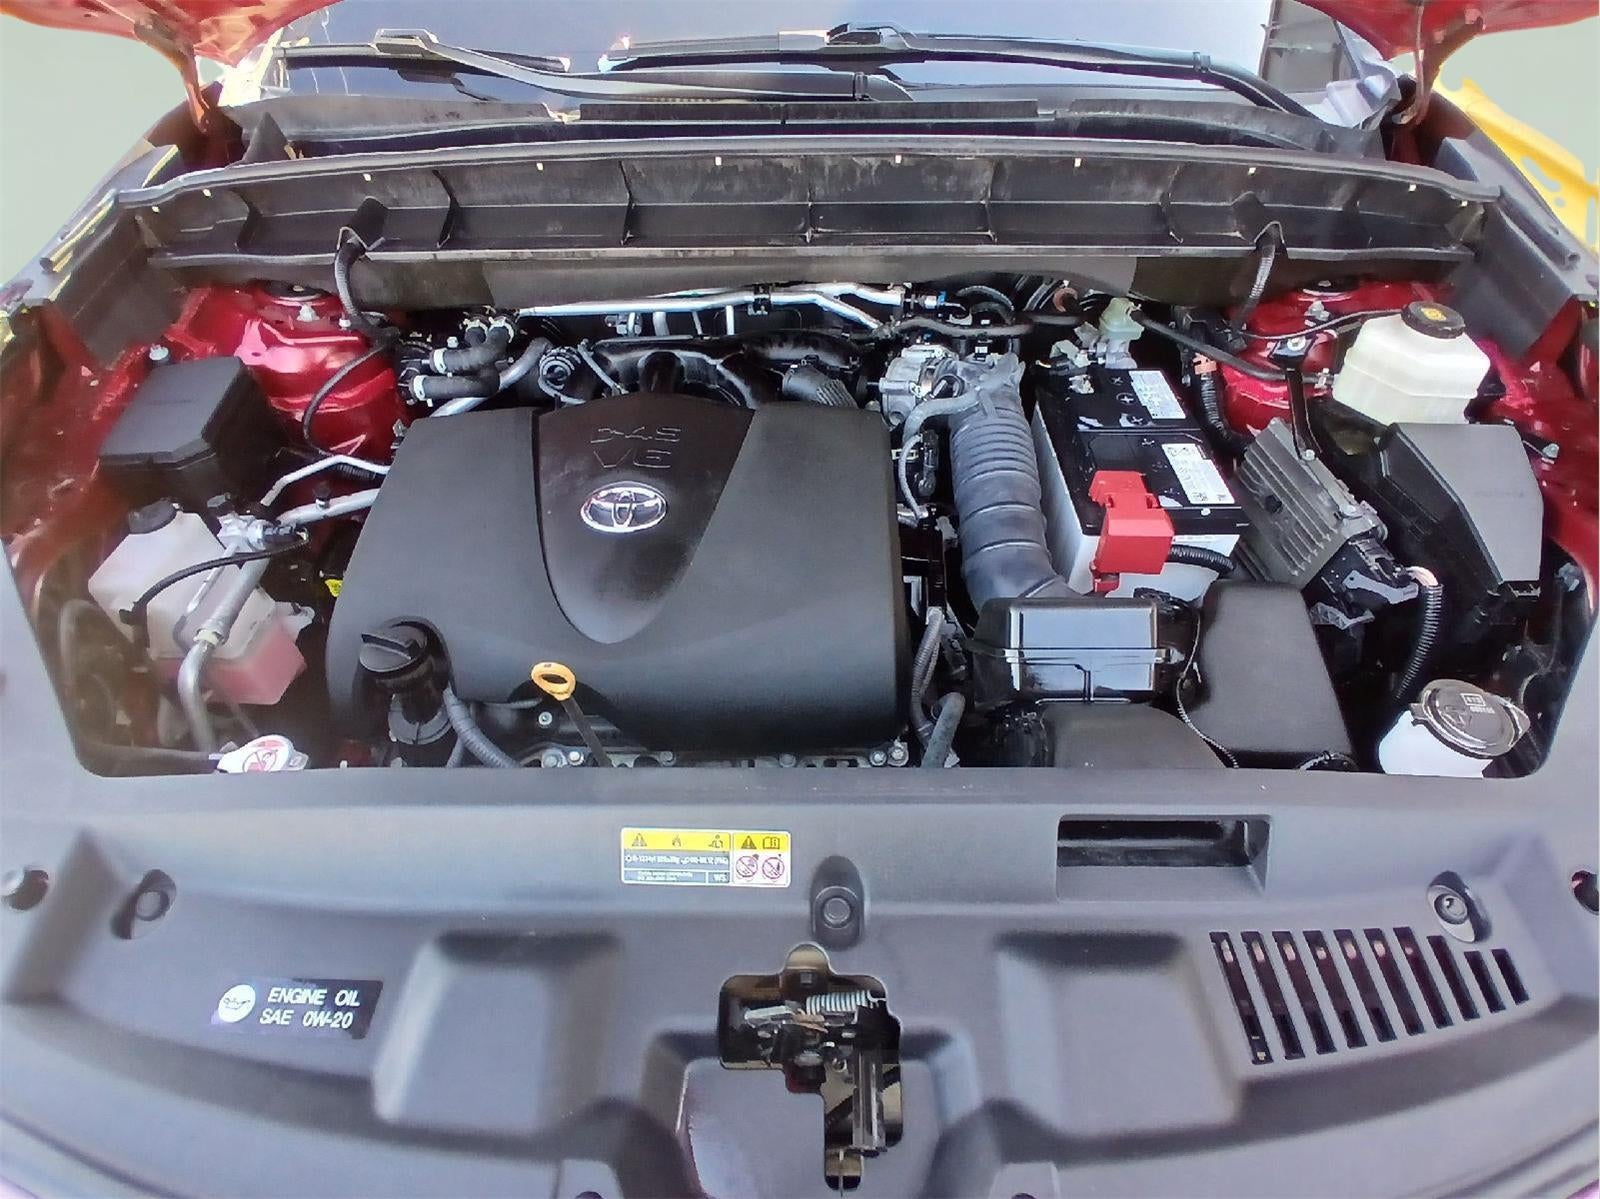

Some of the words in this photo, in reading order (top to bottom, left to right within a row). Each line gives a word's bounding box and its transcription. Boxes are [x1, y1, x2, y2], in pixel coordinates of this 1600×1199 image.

[267, 986, 328, 1006] ENGINE
[334, 989, 361, 1007] OIL
[259, 1007, 295, 1025] SAE
